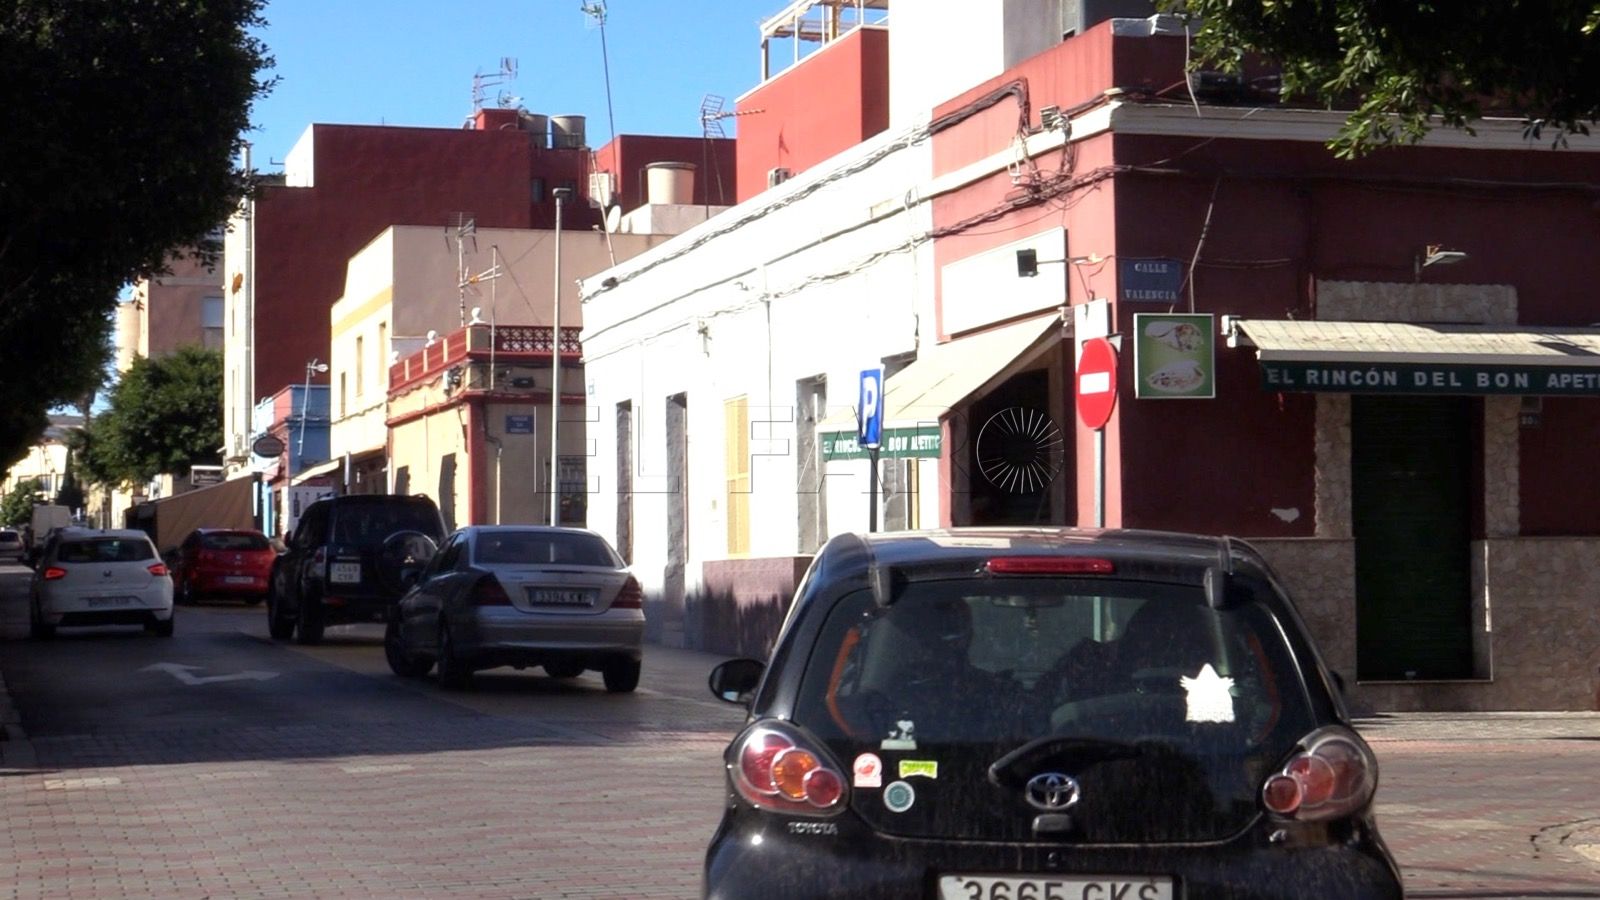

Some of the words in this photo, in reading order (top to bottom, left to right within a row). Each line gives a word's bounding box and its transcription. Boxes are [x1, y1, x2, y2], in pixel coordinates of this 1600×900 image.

[1134, 262, 1168, 273] CALLE
[1125, 289, 1177, 300] VALENCIA
[1267, 369, 1294, 384] EL
[1306, 367, 1397, 386] RINCÓN
[1414, 371, 1462, 387] DEL
[1476, 372, 1529, 388] BON
[788, 822, 839, 836] TOYOTA
[963, 880, 1064, 900] 3665
